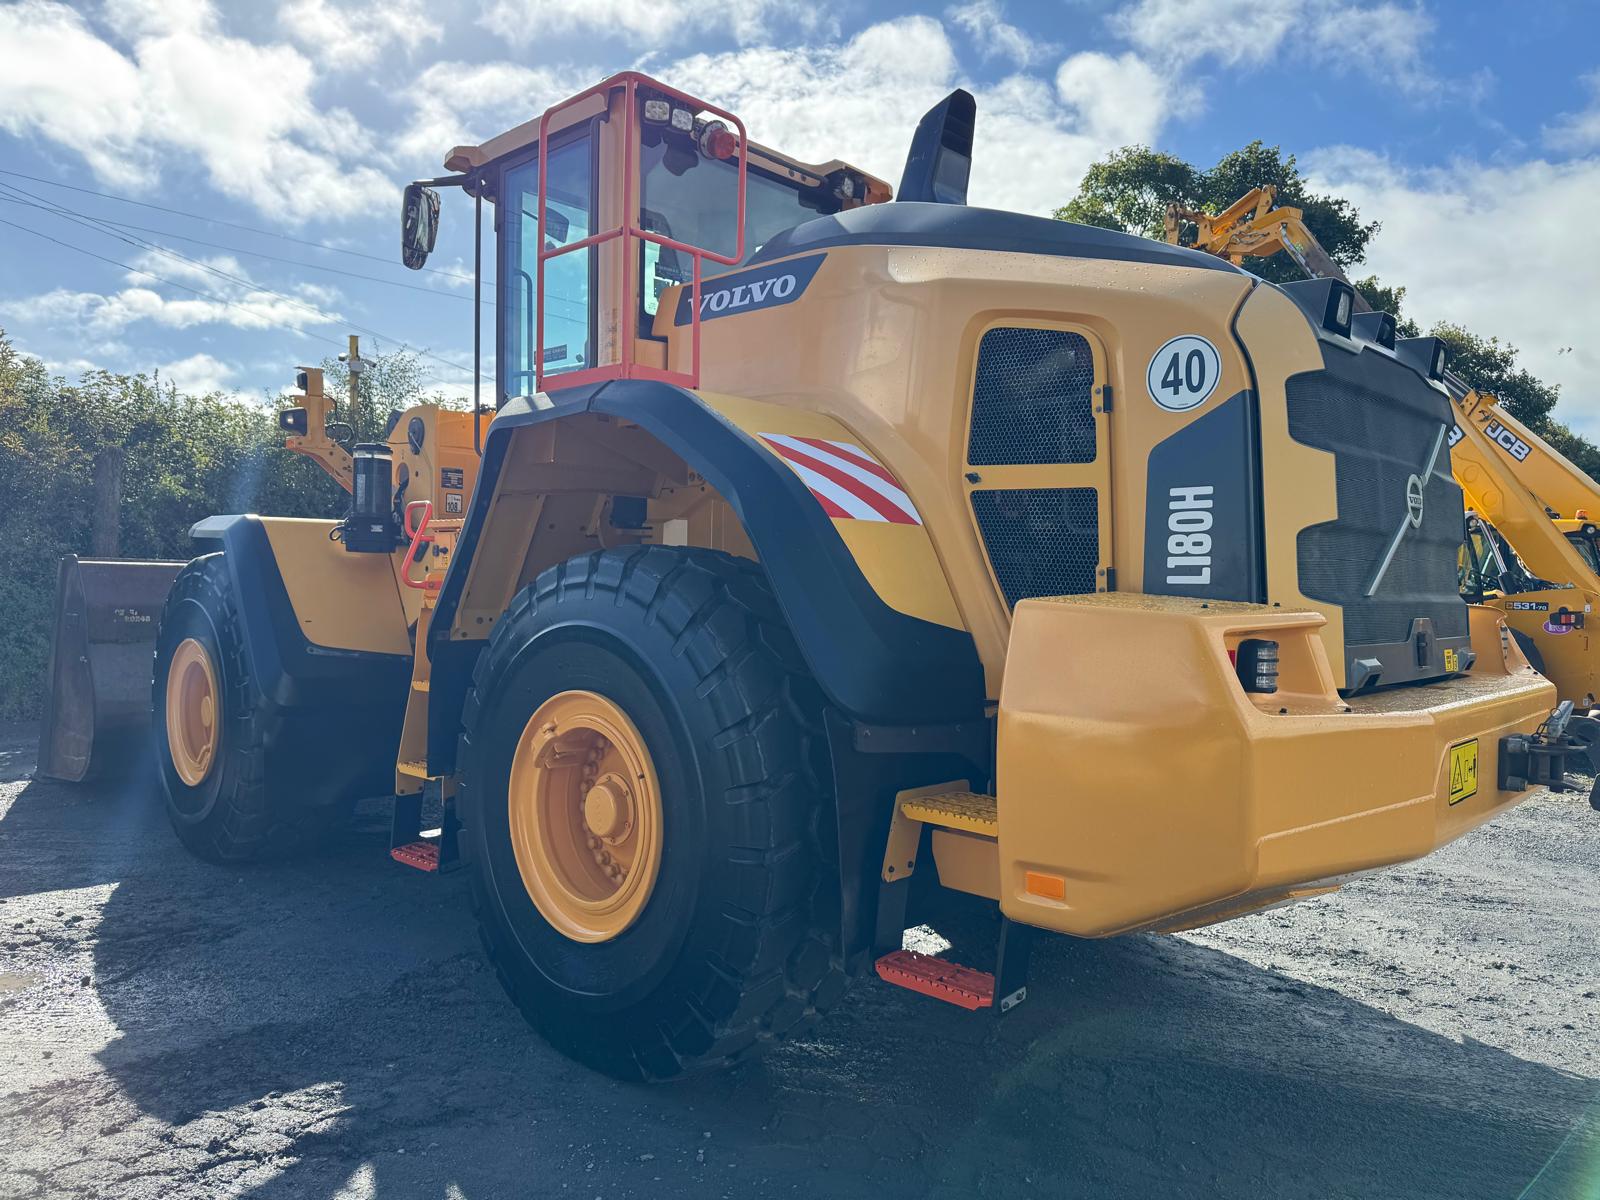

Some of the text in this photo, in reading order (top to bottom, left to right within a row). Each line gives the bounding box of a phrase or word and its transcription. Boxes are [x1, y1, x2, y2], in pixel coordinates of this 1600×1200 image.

[688, 274, 797, 314] VOLVO
[1161, 349, 1206, 396] 40
[1485, 422, 1531, 461] JCB
[1166, 485, 1214, 585] L180H
